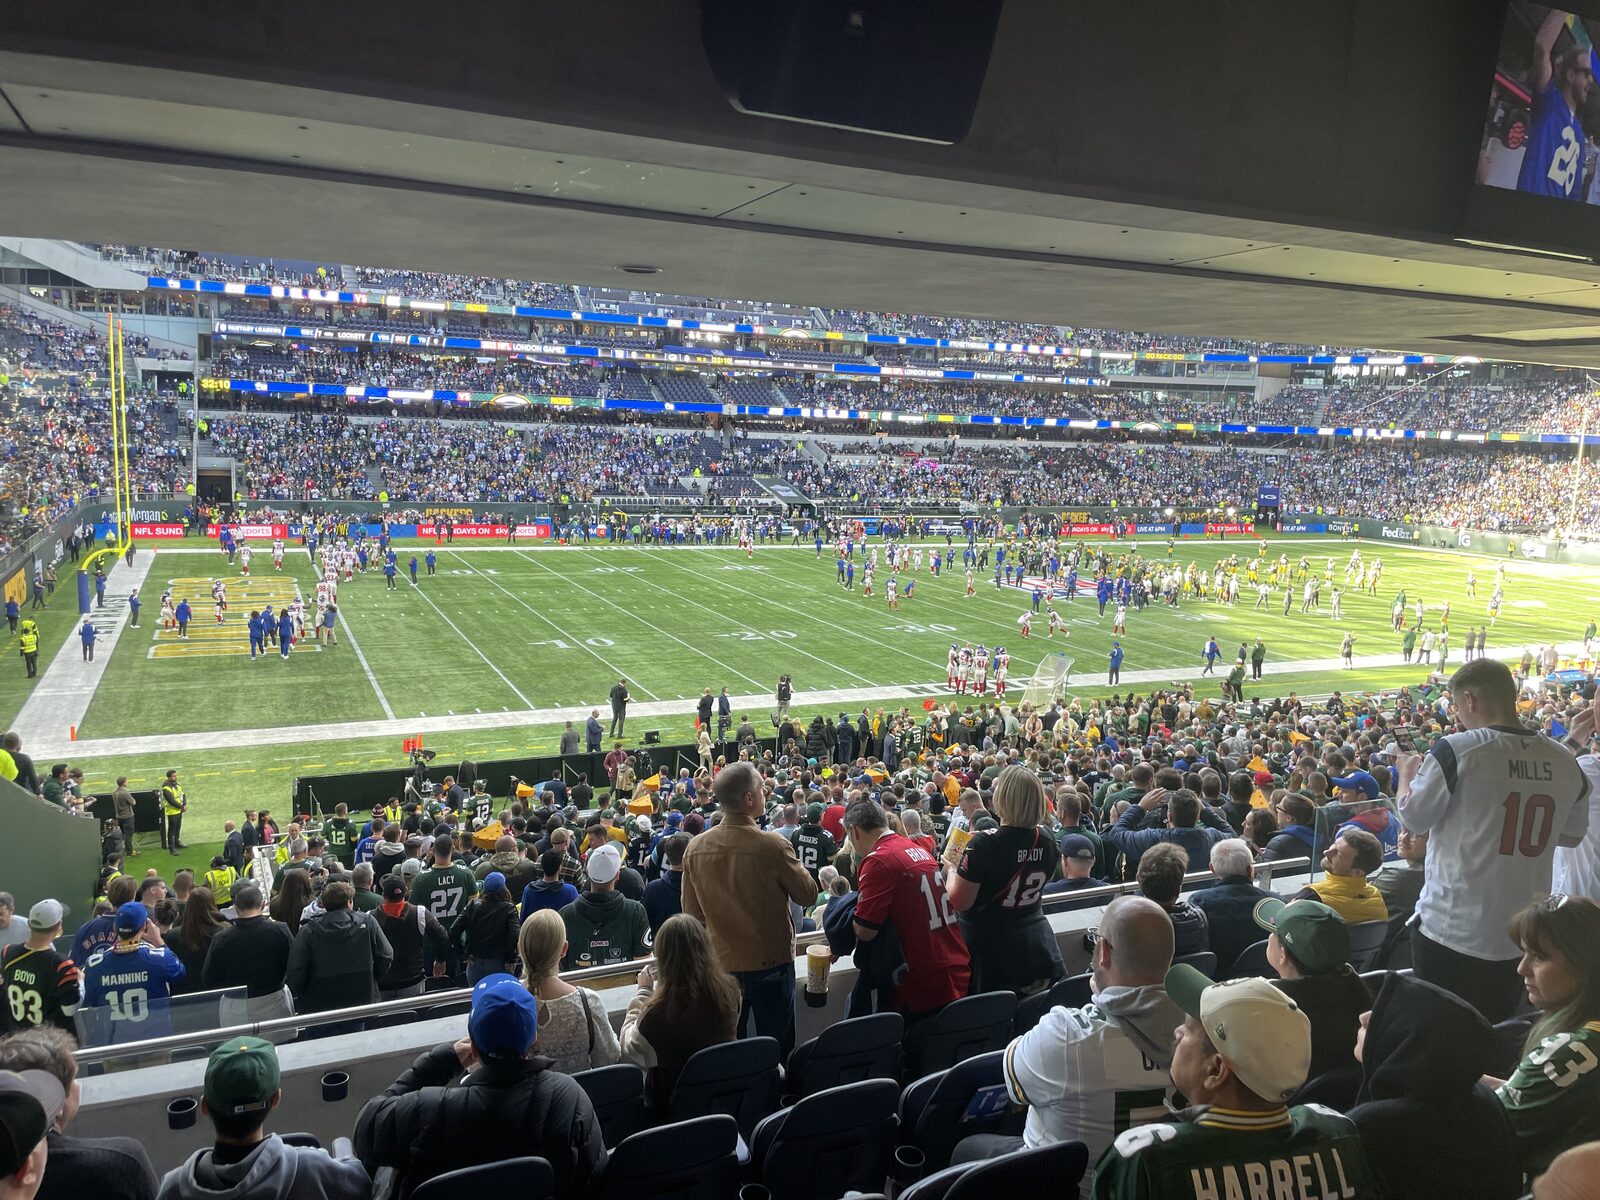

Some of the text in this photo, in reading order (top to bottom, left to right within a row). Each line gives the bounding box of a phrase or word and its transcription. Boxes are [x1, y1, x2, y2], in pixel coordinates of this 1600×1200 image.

[1547, 126, 1581, 197] 26
[513, 343, 542, 352] LONDON
[543, 345, 566, 354] GAMES
[201, 378, 231, 389] 32:10
[129, 508, 161, 523] Morgan
[135, 527, 184, 536] NFL SUND
[422, 527, 437, 535] NFL
[440, 527, 476, 535] SNDAYS
[478, 527, 490, 535] ON
[495, 526, 508, 536] sky
[1382, 526, 1410, 540] FedEx
[731, 630, 798, 641] 20
[893, 623, 958, 633] 30
[912, 733, 921, 744] 12
[1508, 759, 1553, 782] MILLS
[476, 804, 489, 821] 12
[1499, 791, 1556, 858] 10
[331, 830, 346, 845] 12
[798, 845, 818, 869] 12
[1017, 848, 1044, 863] BRADY
[437, 875, 455, 886] LACY
[1002, 872, 1047, 908] 12
[430, 886, 463, 918] 27
[920, 870, 958, 931] 12
[82, 931, 117, 950] GIAN
[14, 969, 36, 985] BOYD
[101, 970, 149, 986] MANNING
[7, 984, 43, 1025] 83
[105, 987, 150, 1023] 10
[1190, 1148, 1356, 1200] HARRELL
